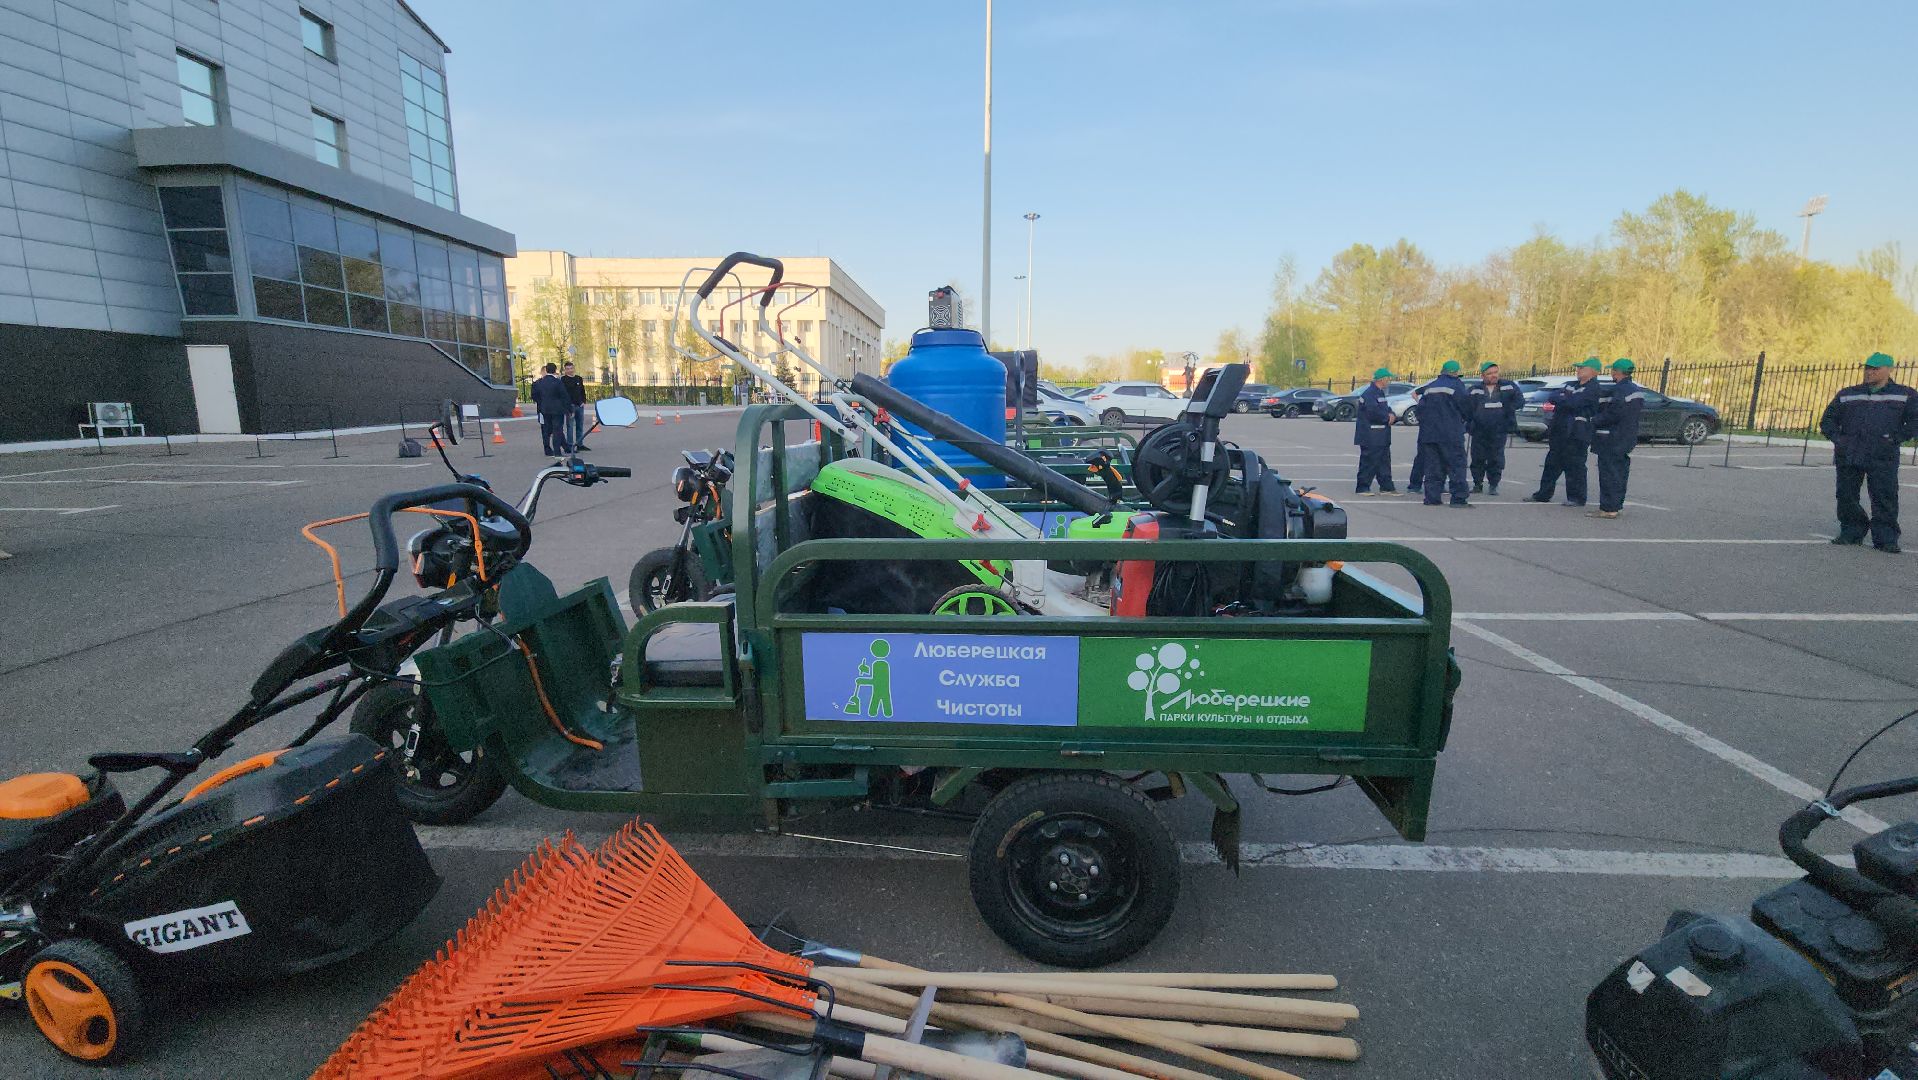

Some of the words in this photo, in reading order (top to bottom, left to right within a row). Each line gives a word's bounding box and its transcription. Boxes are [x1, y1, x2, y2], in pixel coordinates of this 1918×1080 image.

[914, 641, 1046, 660] Люберецкая
[939, 669, 1020, 688] Служба
[936, 699, 1022, 717] Чистоты
[1160, 688, 1311, 712] Люберецкие
[1159, 713, 1195, 722] ПАРКИ
[1197, 714, 1252, 723] КУЛЬТУРЫ
[1255, 715, 1264, 724] И
[1266, 715, 1309, 725] ОТДЫХА
[132, 909, 238, 947] GIGANT
